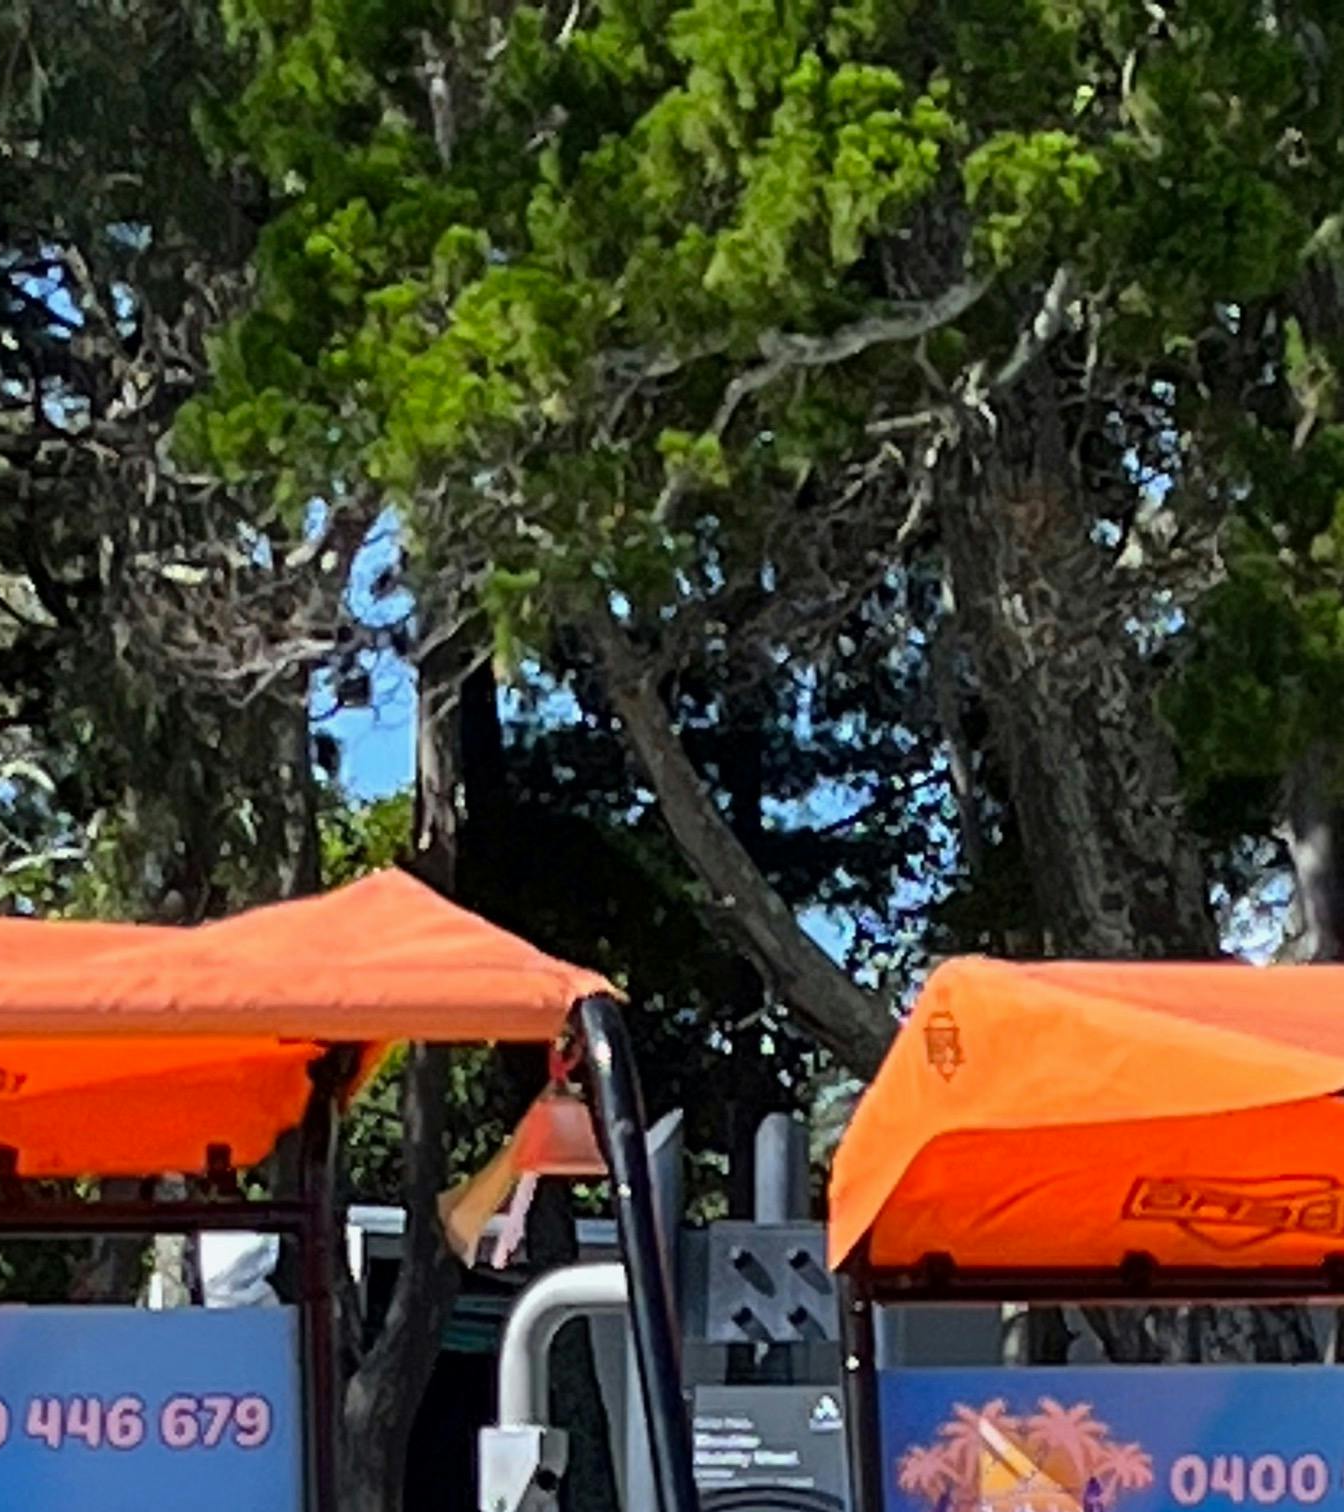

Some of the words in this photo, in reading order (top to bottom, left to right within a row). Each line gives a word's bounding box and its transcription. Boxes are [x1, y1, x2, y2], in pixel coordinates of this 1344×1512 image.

[23, 1393, 145, 1451] 446
[159, 1392, 273, 1449] 679
[1169, 1452, 1327, 1508] 0400
